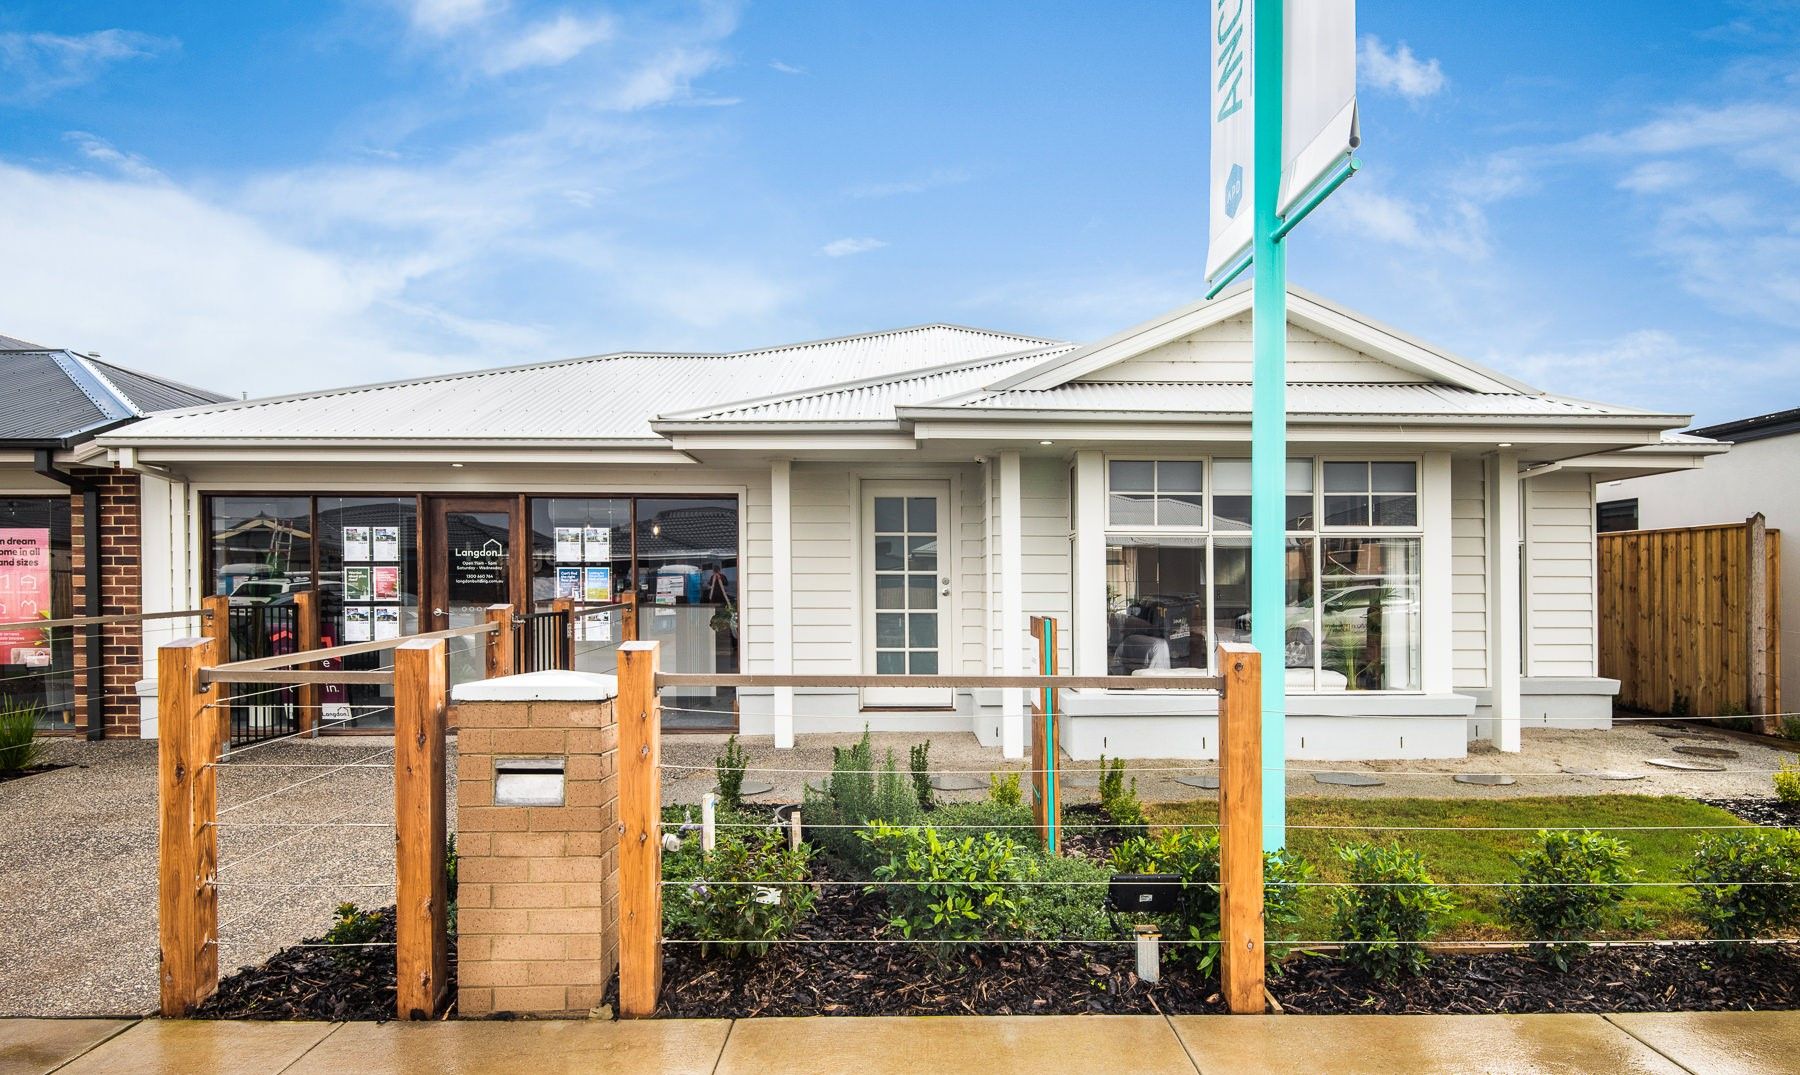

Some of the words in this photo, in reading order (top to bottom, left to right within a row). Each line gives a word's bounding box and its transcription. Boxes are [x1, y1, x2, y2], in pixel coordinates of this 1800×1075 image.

[1217, 0, 1243, 123] ANC
[19, 547, 28, 556] in
[29, 547, 41, 556] all
[455, 545, 498, 559] Langdon
[16, 558, 39, 566] sizes
[325, 682, 340, 693] in.
